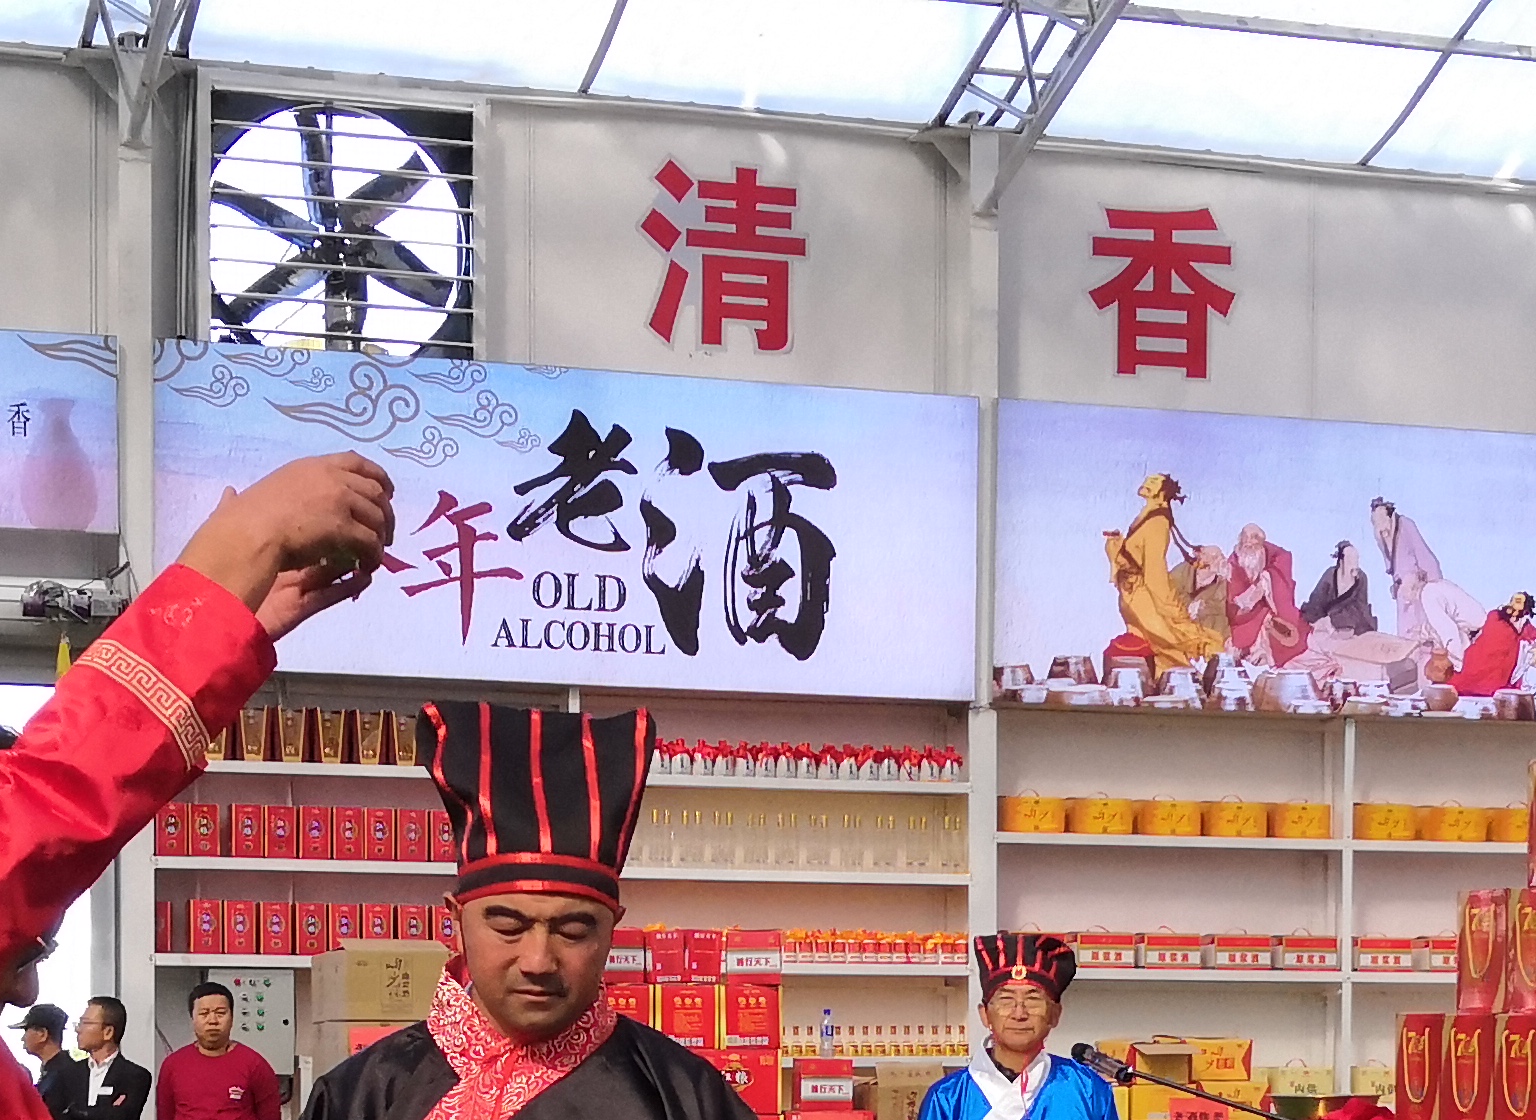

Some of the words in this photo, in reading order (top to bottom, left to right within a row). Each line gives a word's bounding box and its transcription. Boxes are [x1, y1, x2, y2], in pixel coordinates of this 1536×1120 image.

[640, 158, 807, 351] 清
[1088, 207, 1236, 379] 香
[531, 572, 627, 612] OLD
[491, 616, 668, 656] ALCOHOL
